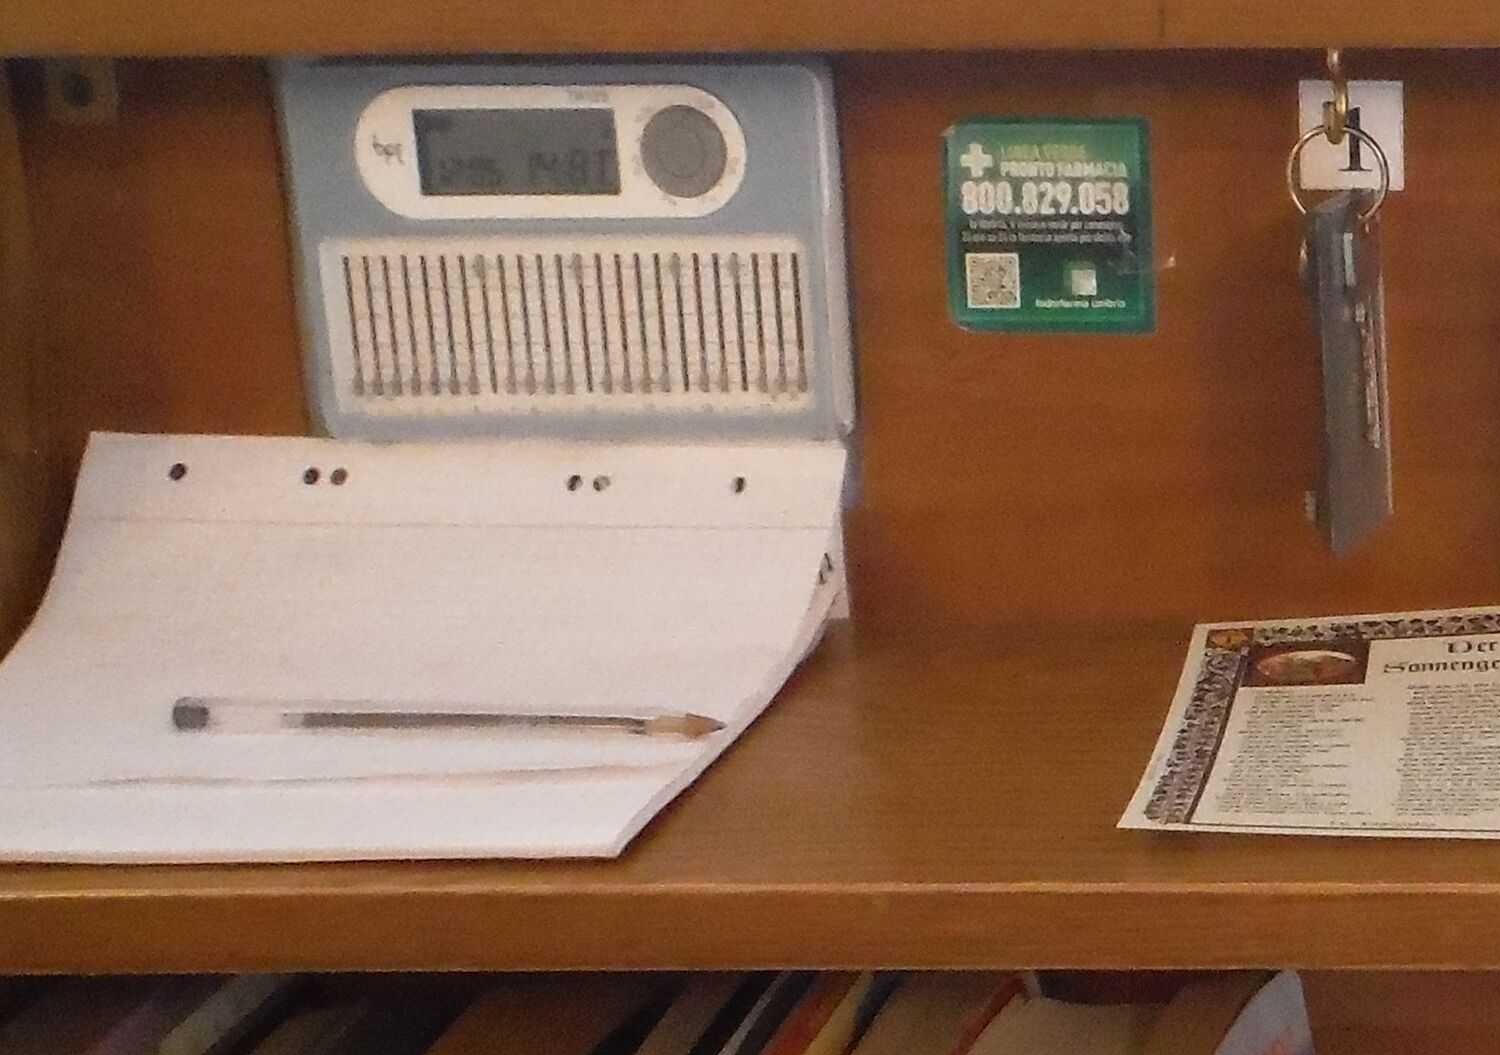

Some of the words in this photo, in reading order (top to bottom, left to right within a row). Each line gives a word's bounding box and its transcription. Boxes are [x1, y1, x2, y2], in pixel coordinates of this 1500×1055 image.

[1338, 106, 1372, 171] 1
[961, 180, 1130, 215] 800.829.058
[1446, 639, 1499, 656] Der
